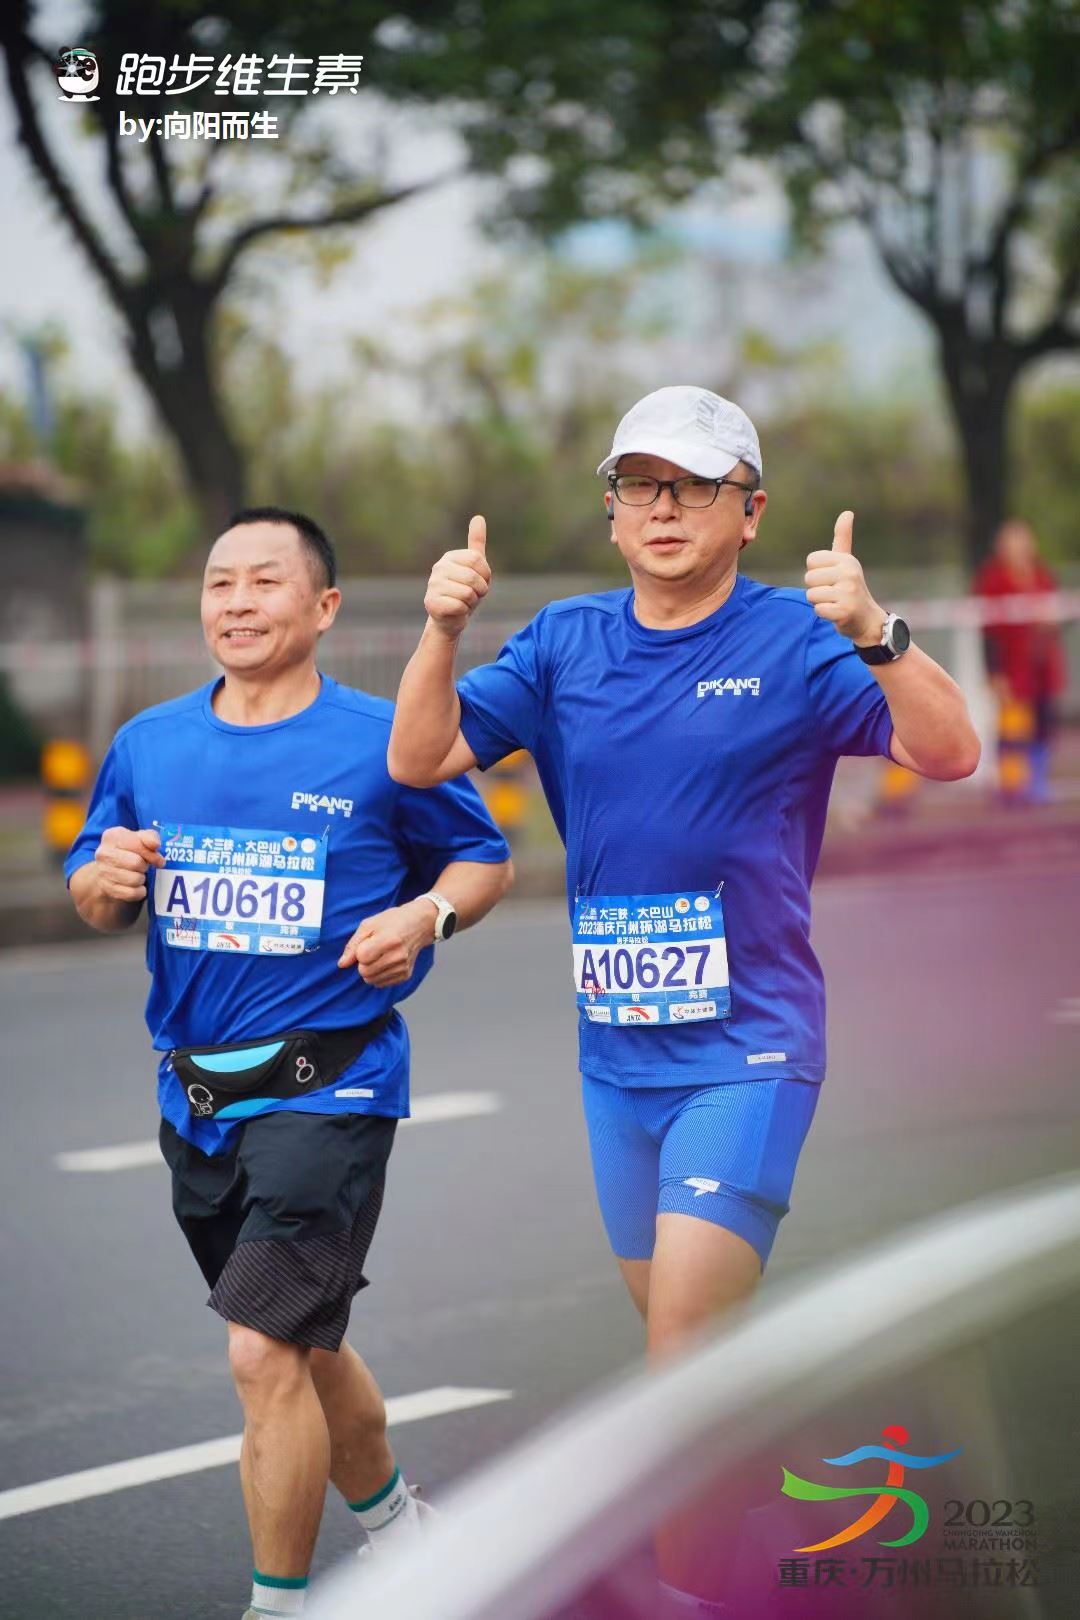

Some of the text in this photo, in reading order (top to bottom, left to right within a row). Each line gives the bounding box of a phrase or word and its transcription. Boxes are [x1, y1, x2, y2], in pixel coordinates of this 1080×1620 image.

[165, 848, 315, 871] 2023重庆万州环湖马拉松
[166, 875, 306, 922] A10618
[599, 906, 674, 920] 大三峡·大巴山
[577, 915, 713, 936] 2023重庆万州环湖马拉松
[581, 945, 711, 990] A10627
